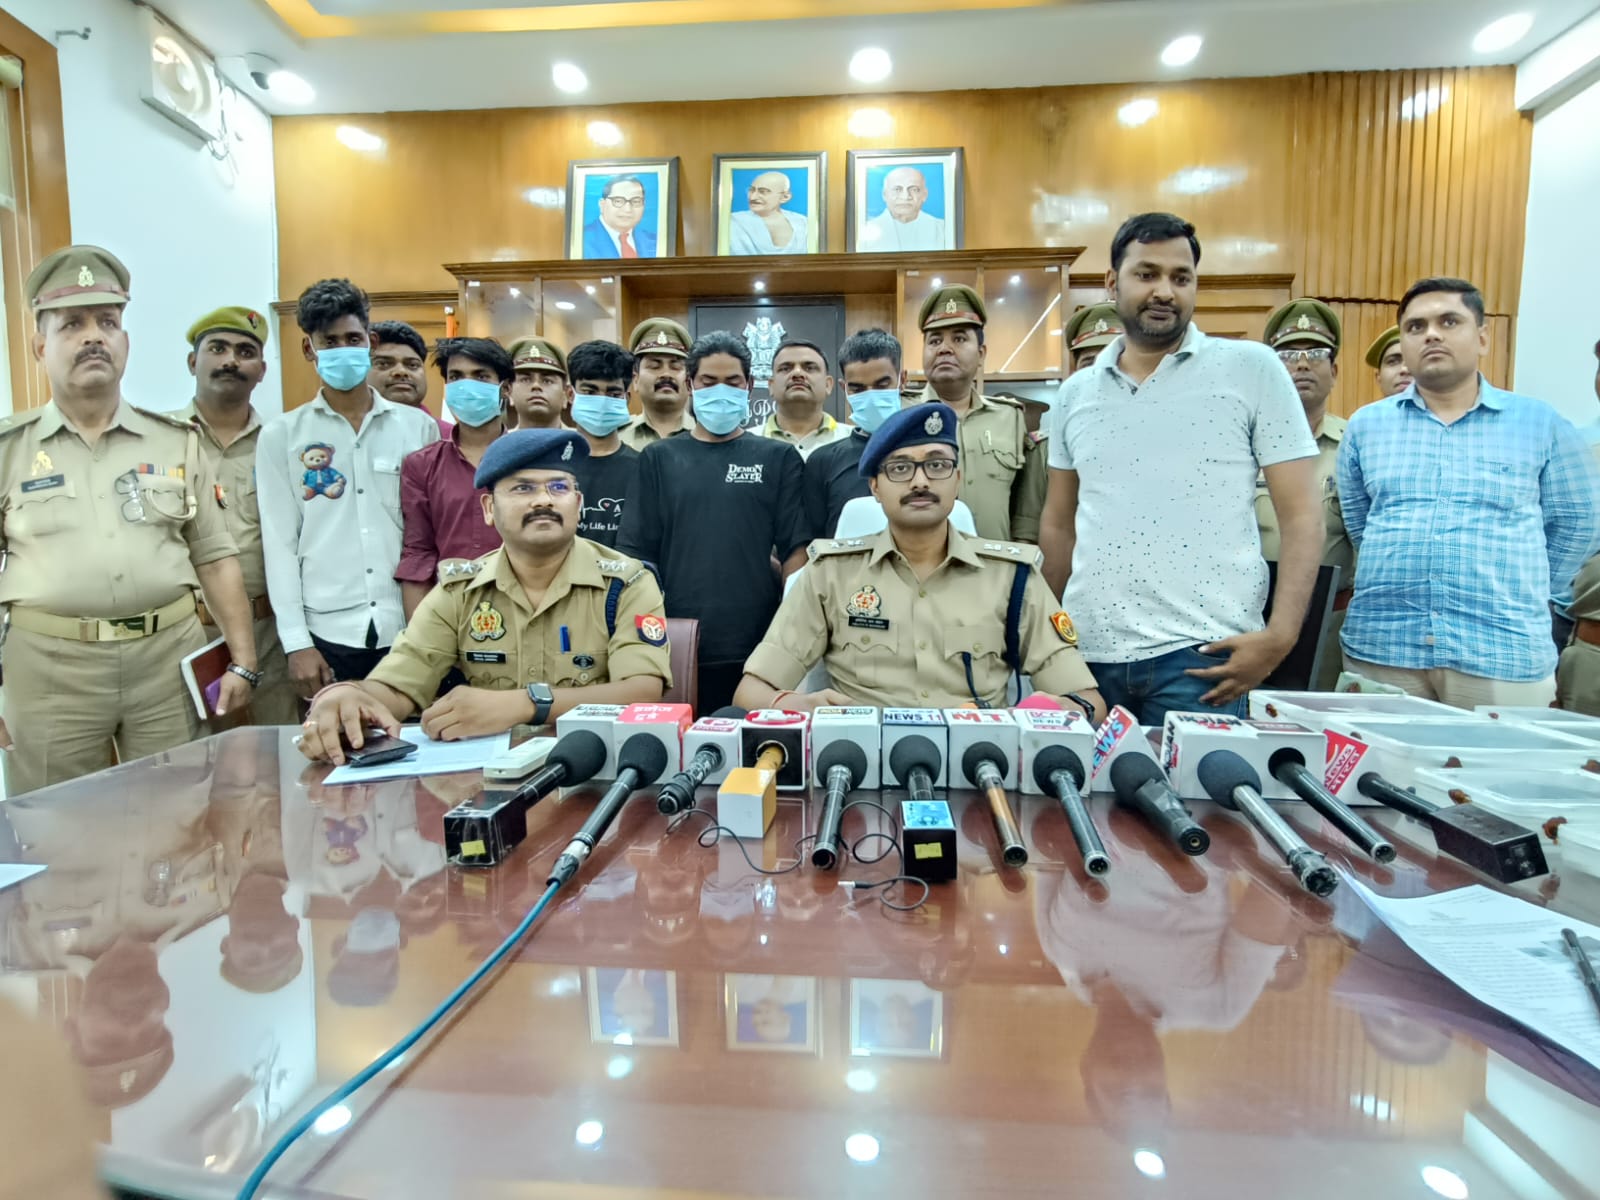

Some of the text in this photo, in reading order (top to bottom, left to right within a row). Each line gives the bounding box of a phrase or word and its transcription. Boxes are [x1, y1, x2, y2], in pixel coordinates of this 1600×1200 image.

[728, 464, 763, 473] DEMON
[725, 473, 763, 483] SLAYER
[589, 522, 606, 530] Life
[884, 713, 942, 721] NEWS 11
[1092, 719, 1124, 769] EWS
